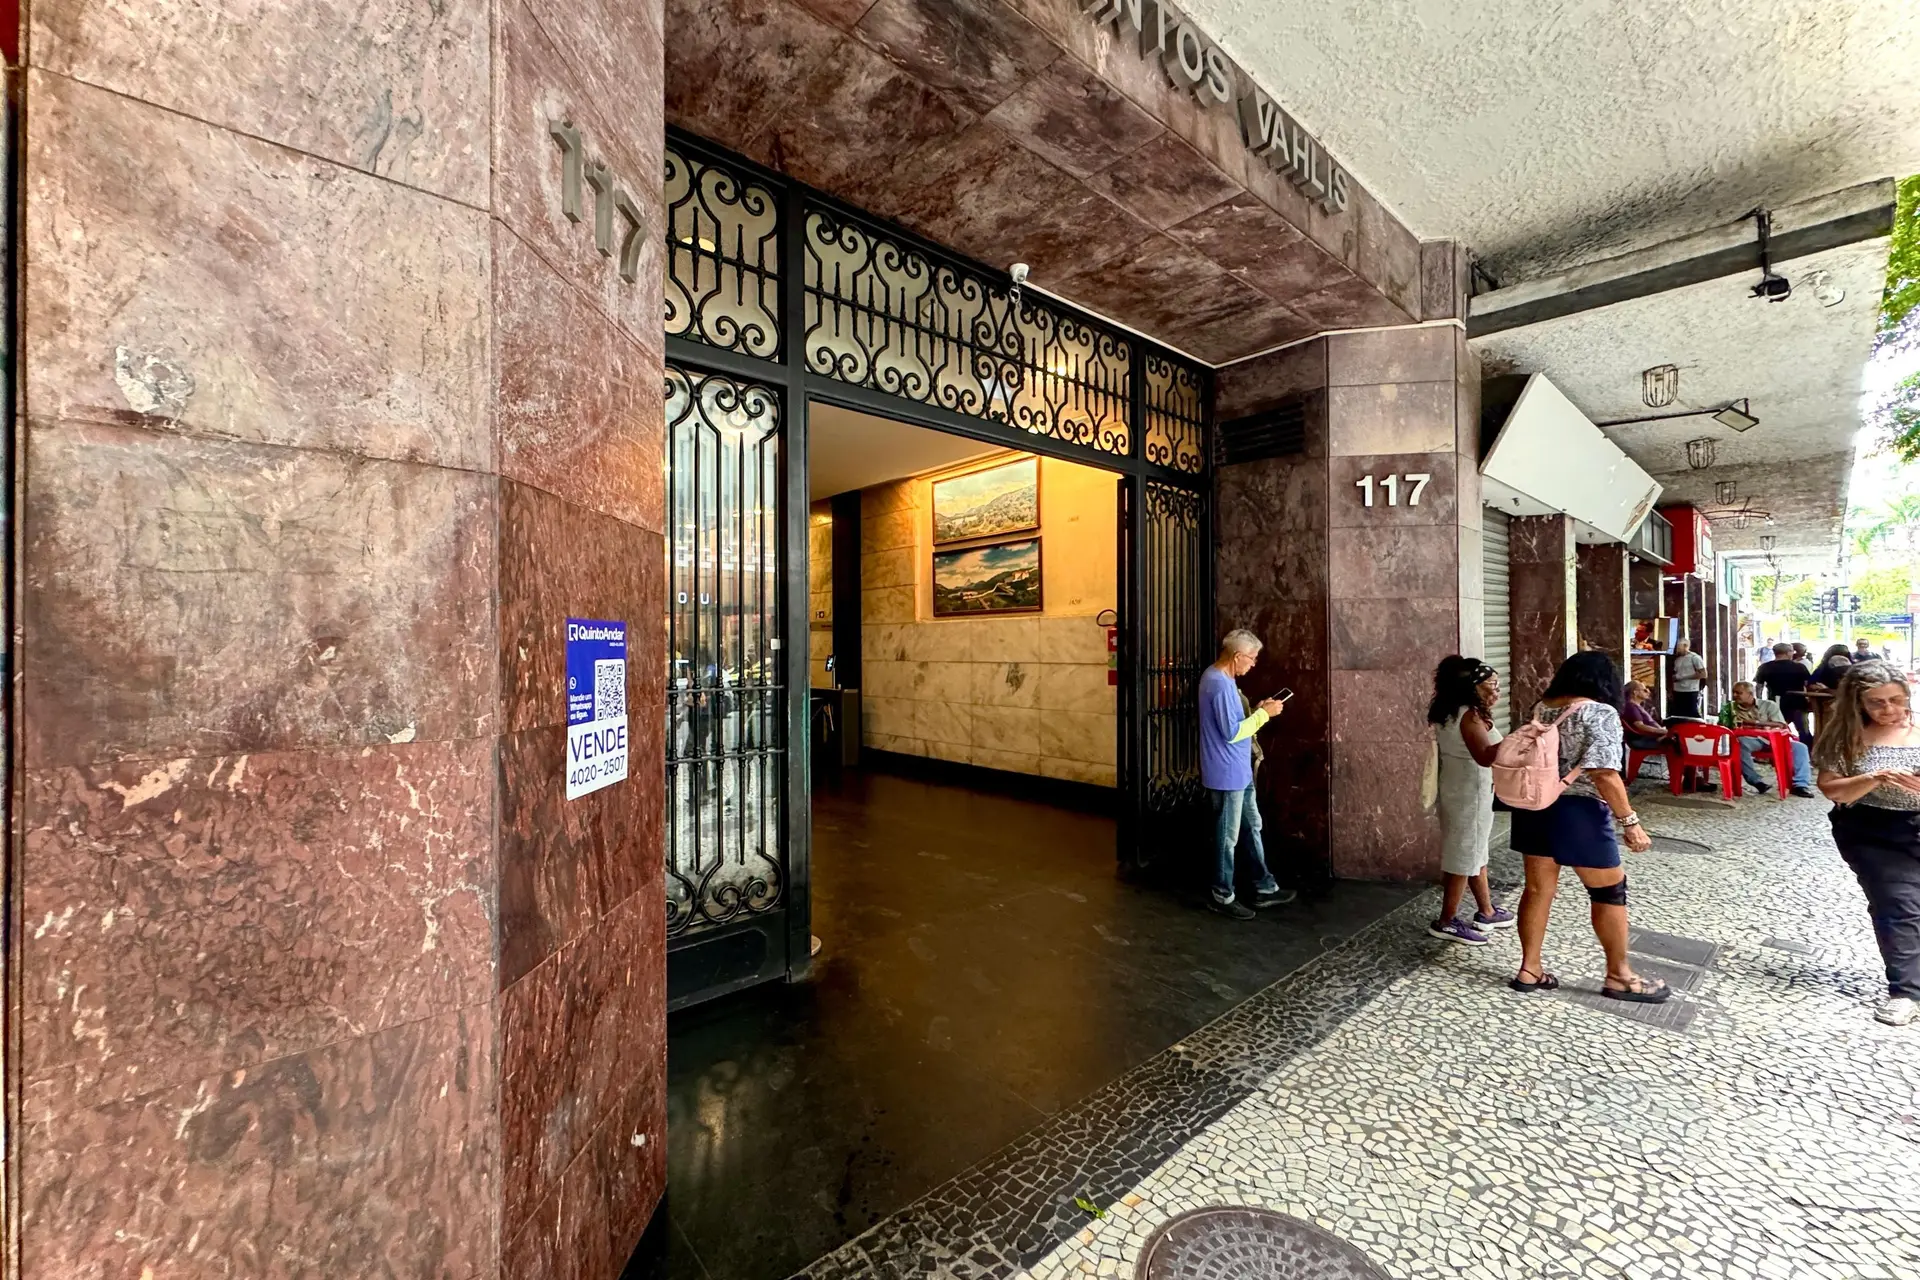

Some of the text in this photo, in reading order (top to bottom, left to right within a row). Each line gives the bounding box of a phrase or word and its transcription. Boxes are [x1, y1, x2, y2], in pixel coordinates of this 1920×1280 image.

[1244, 86, 1349, 215] VAHLIS
[549, 119, 648, 284] 117
[1355, 473, 1431, 507] 117
[578, 625, 625, 641] QuintoAndar
[570, 725, 626, 763] VENDE
[570, 755, 625, 787] 4020-2507
